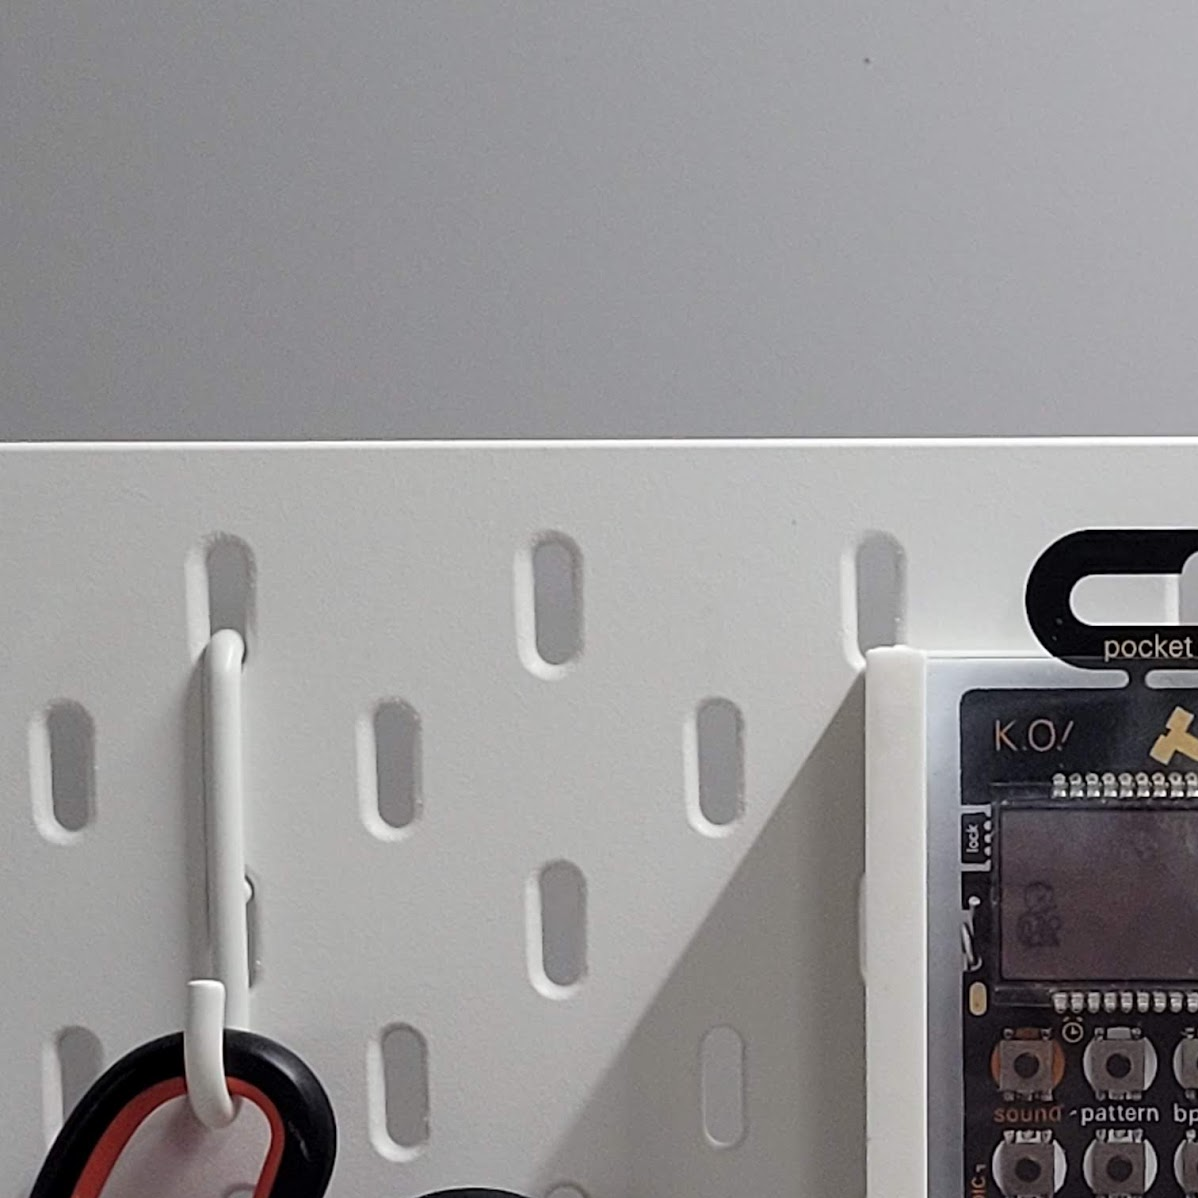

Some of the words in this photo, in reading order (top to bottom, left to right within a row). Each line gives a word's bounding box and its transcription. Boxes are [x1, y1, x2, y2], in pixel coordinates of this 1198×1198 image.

[1104, 633, 1193, 662] pocket
[965, 824, 979, 853] lock
[994, 1105, 1063, 1122] sound
[1082, 1106, 1158, 1126] pattern
